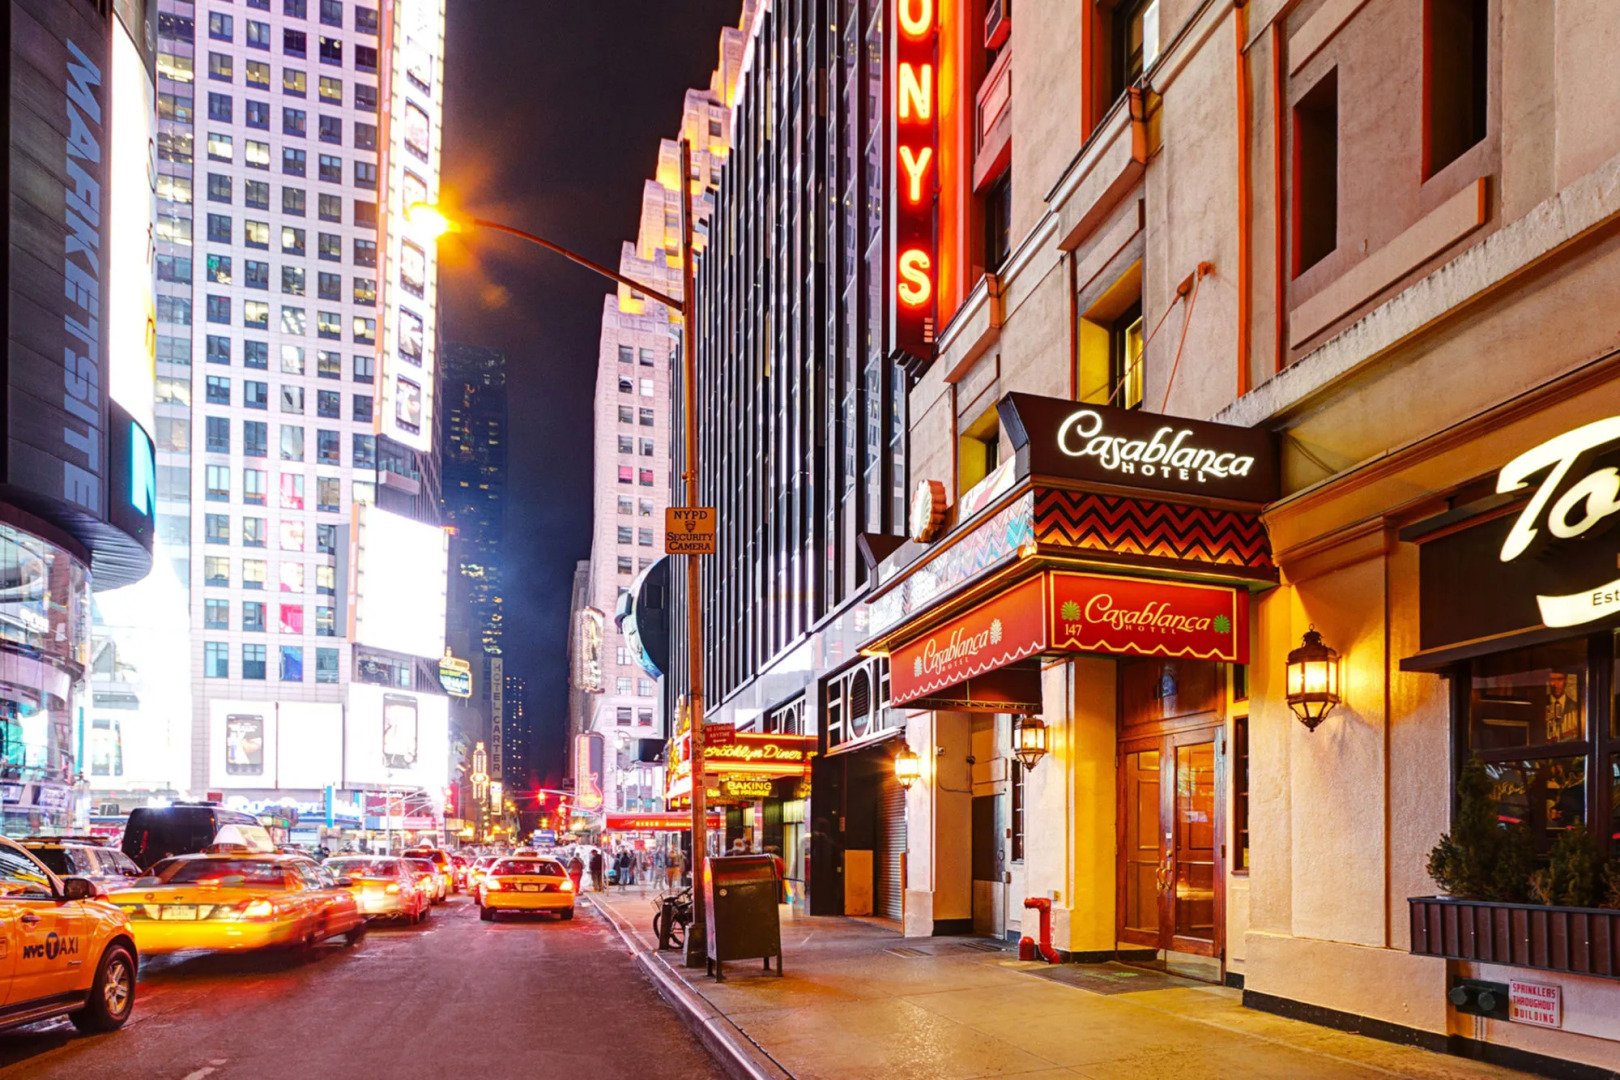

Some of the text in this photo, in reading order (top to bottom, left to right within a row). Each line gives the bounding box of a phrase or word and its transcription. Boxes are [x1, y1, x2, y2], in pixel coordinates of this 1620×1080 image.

[64, 38, 102, 514] MARKETSITE
[1056, 409, 1256, 478] Casablanca
[1121, 461, 1208, 483] HOTEL
[674, 511, 708, 520] NYPD
[667, 532, 713, 541] SECURITY
[669, 542, 710, 550] CAMERA
[1084, 593, 1211, 633] Casablanca
[1064, 624, 1082, 636] 147
[1125, 624, 1176, 635] HOTEL
[923, 627, 989, 675] Casablanca
[942, 657, 969, 672] HOTEL
[493, 663, 501, 773] HOTEL CARTER
[763, 744, 802, 759] Diner
[727, 781, 772, 791] BAKING
[23, 932, 79, 960] NYC TAXI
[1512, 983, 1556, 999] SPRINKLERS
[1513, 995, 1556, 1011] THROUGHOUT
[1514, 1008, 1555, 1024] BUILDING
